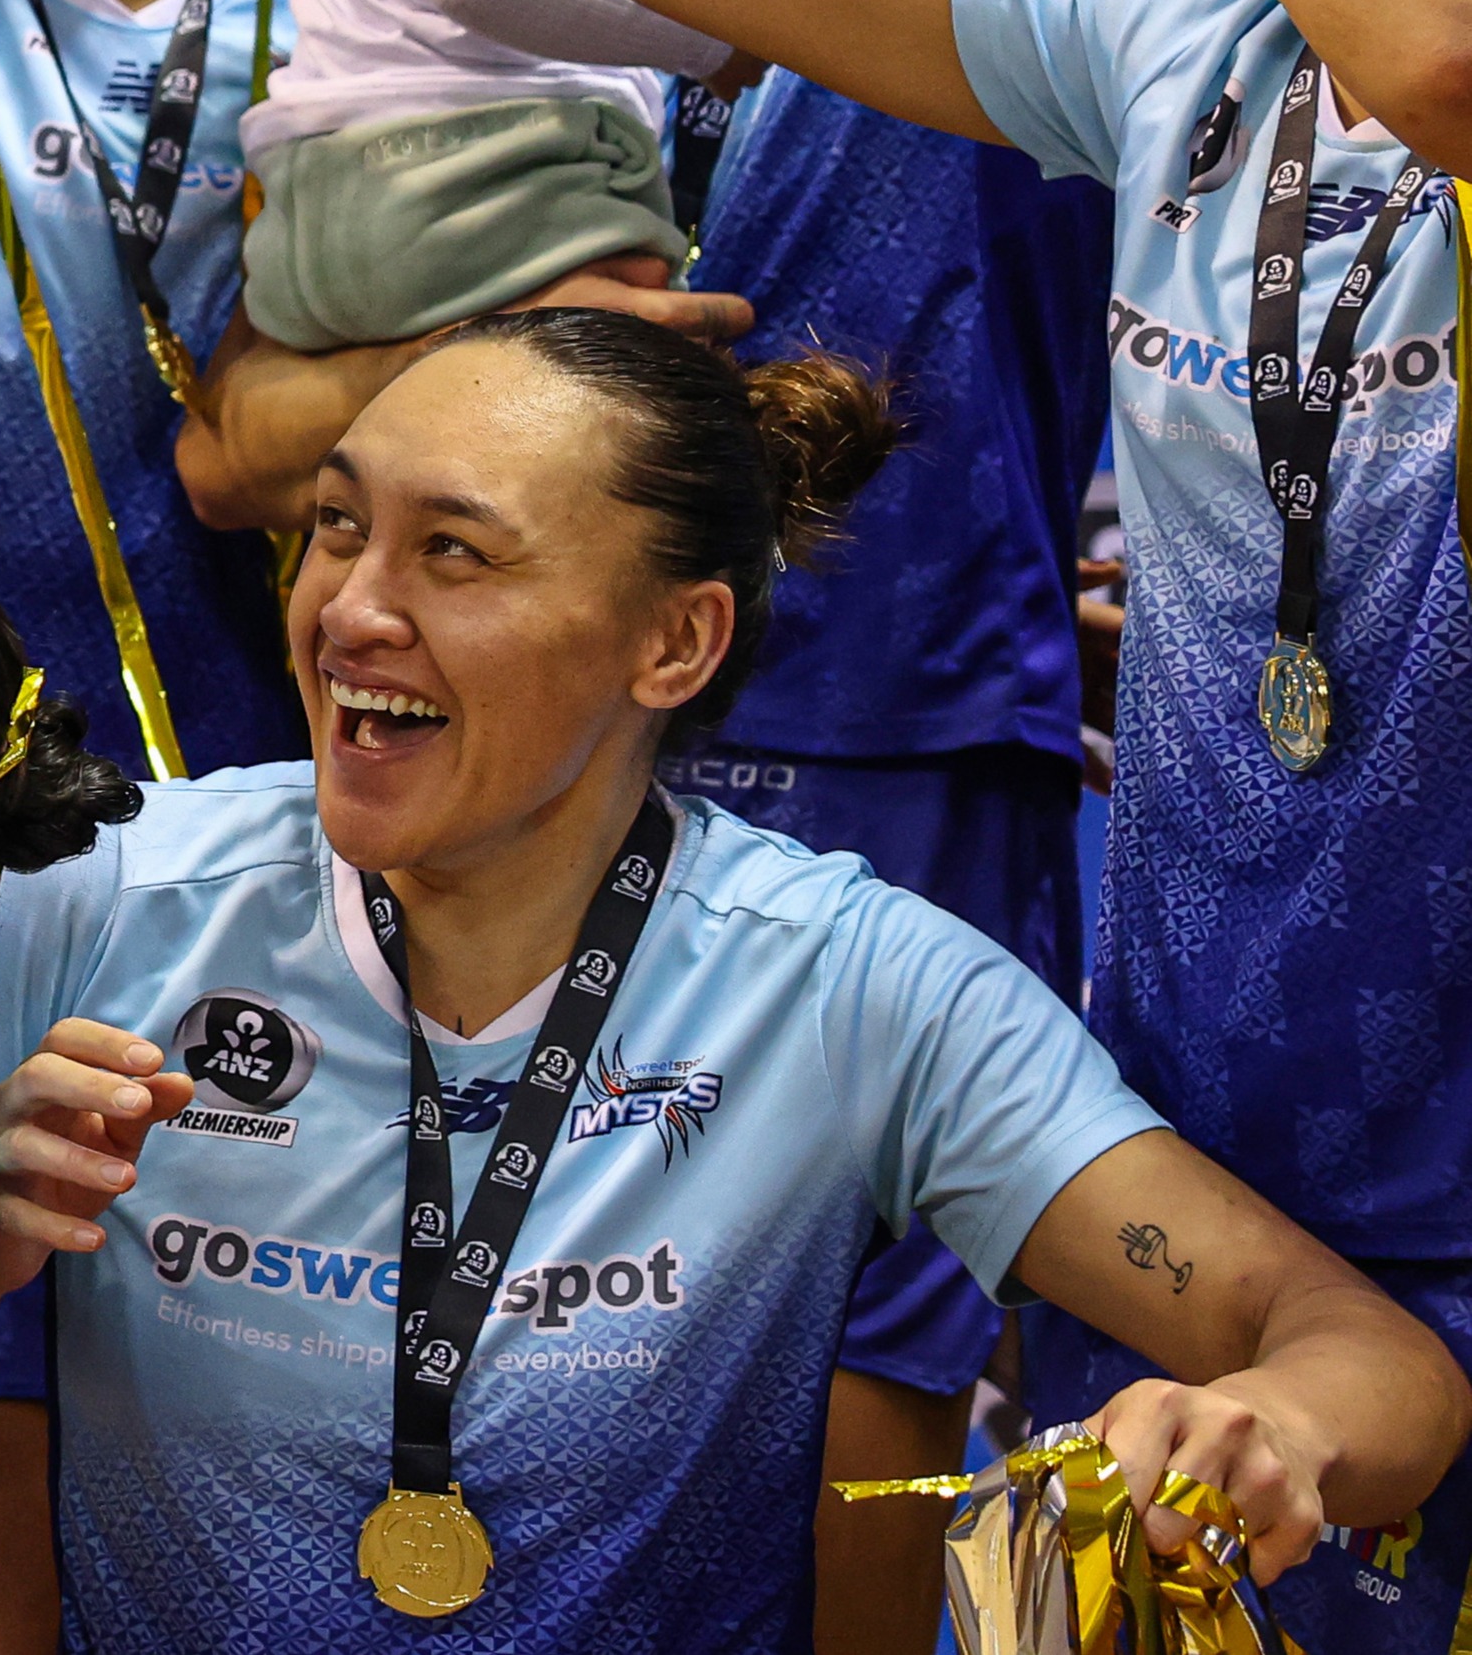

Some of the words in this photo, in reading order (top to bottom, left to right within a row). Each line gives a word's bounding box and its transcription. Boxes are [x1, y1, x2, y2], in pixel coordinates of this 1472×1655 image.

[202, 1048, 273, 1084] ANZ
[627, 1077, 684, 1092] NORTHERN
[167, 1107, 291, 1142] PREMIERSHIP
[152, 1218, 678, 1328] goswespot
[157, 1295, 292, 1353] Effortless
[300, 1329, 397, 1370] shippi
[494, 1340, 663, 1375] everybody
[1354, 1569, 1402, 1605] GROUP
